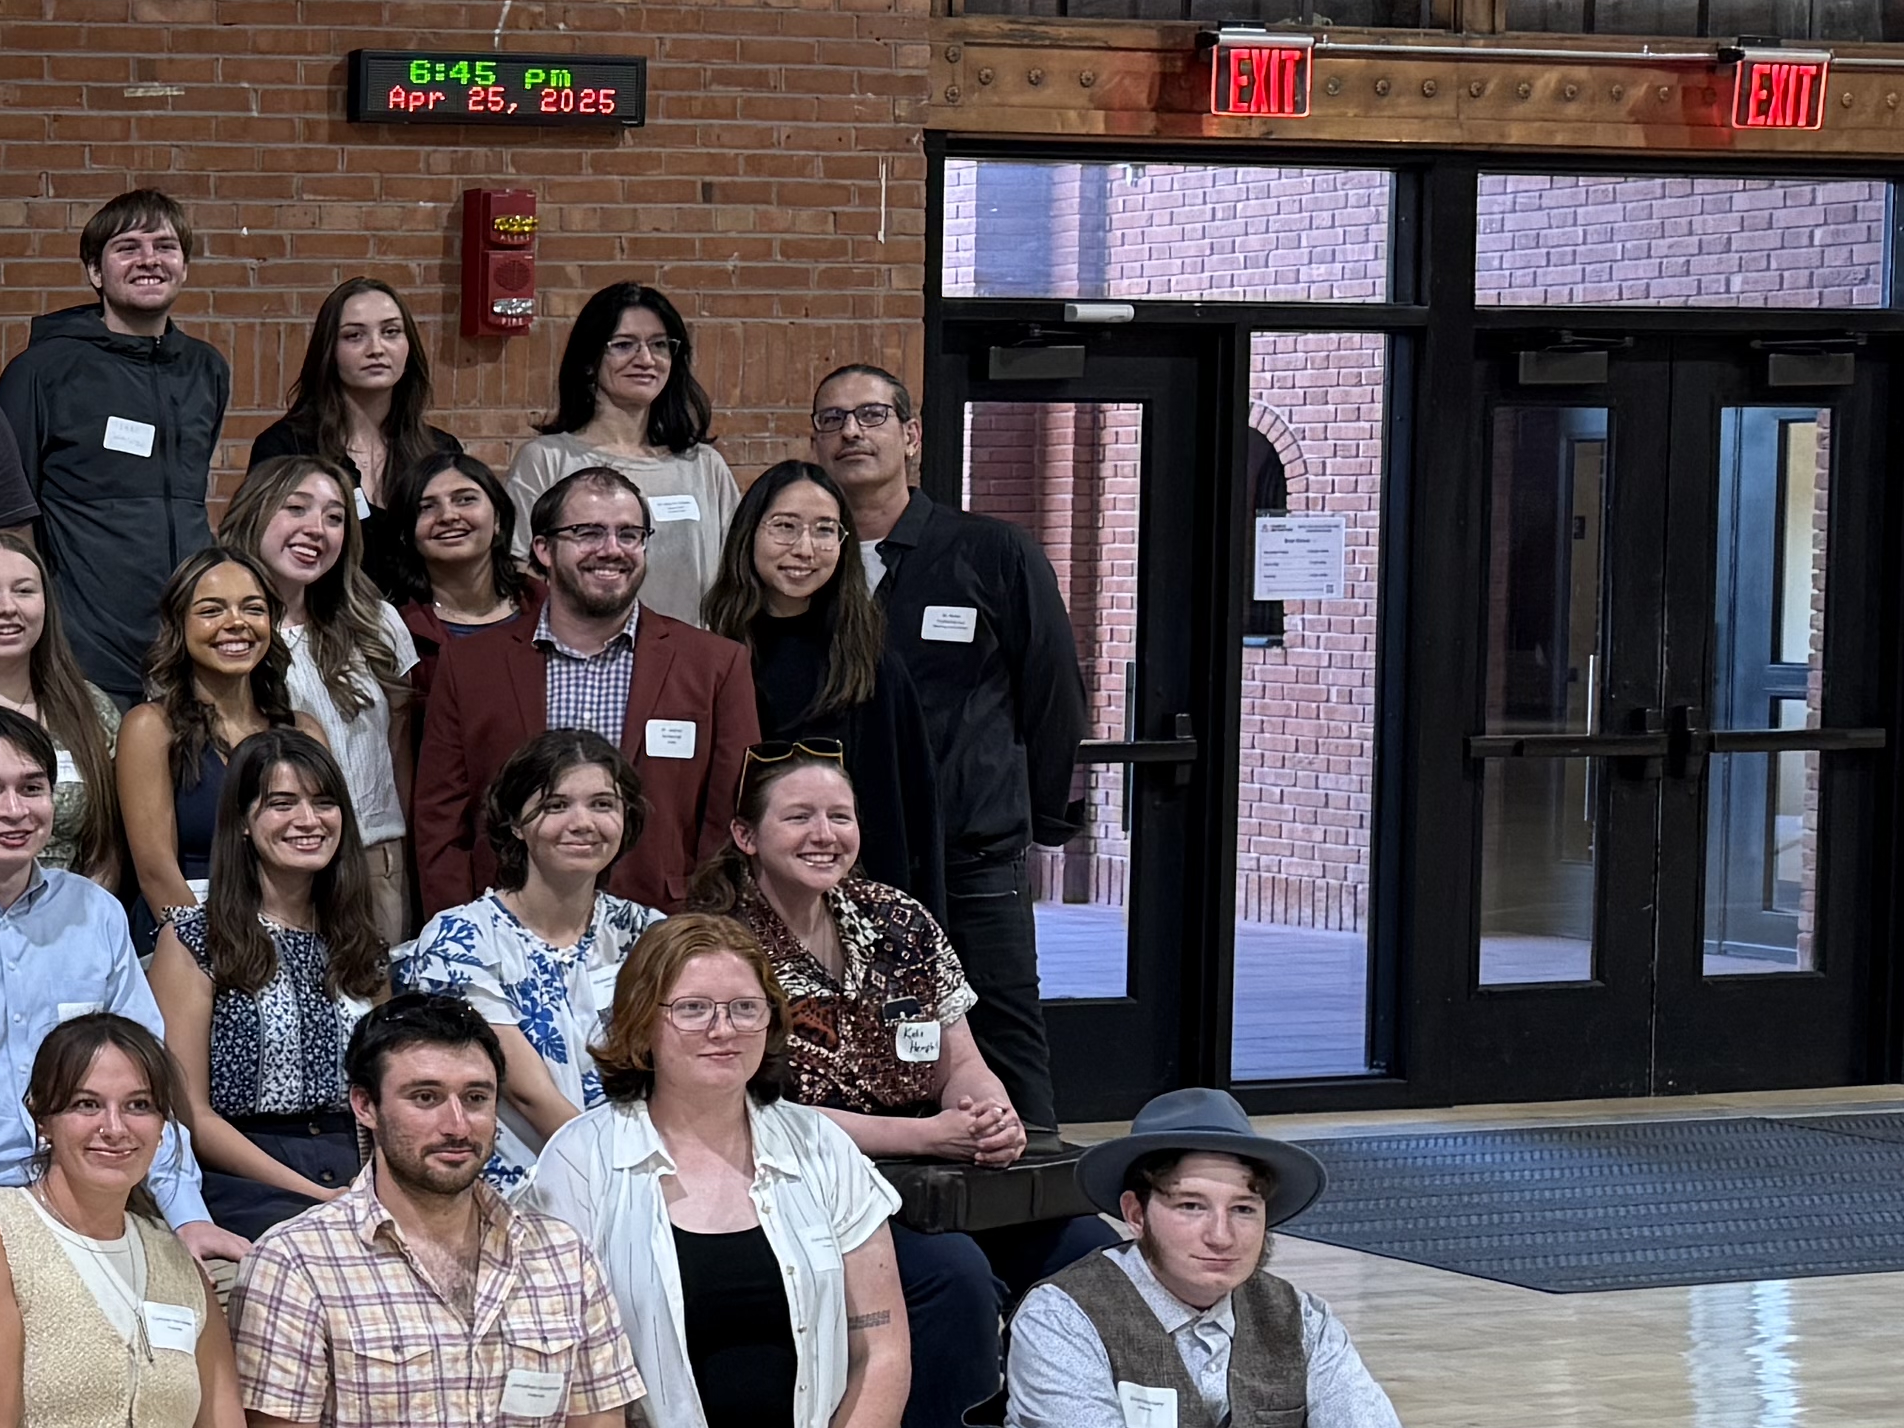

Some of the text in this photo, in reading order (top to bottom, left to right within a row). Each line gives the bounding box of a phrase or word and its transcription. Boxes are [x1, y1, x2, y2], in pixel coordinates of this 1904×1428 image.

[409, 59, 497, 85] 6:45
[1229, 49, 1302, 113] EXIT
[1748, 64, 1817, 127] EXIT
[388, 84, 617, 115] Apr 25, 2025
